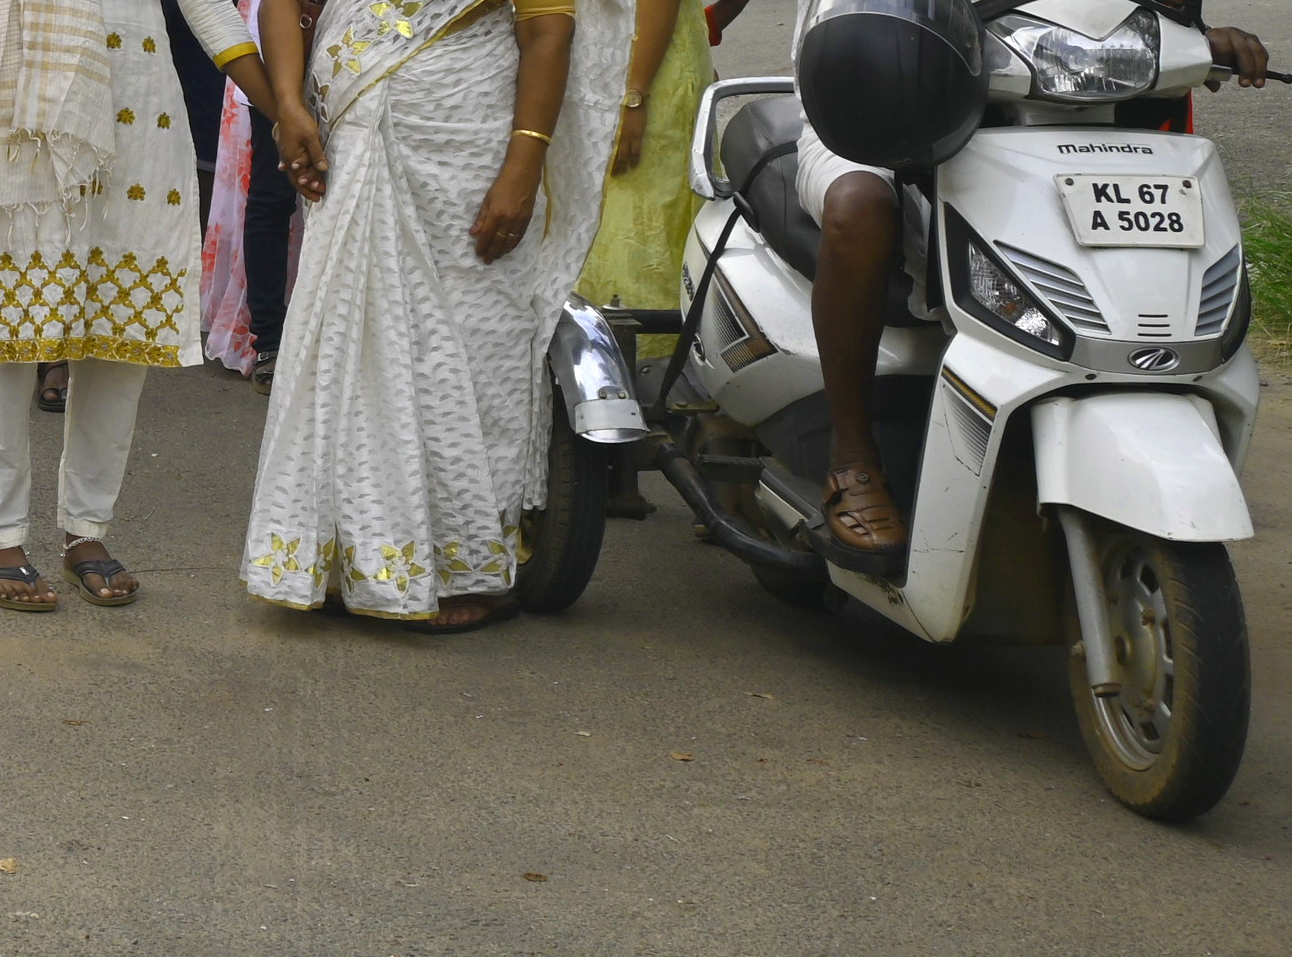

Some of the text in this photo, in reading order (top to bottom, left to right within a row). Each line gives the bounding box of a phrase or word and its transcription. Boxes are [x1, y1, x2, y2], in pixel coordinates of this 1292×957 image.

[1091, 182, 1169, 205] KL 67
[1091, 211, 1184, 233] A 5028
